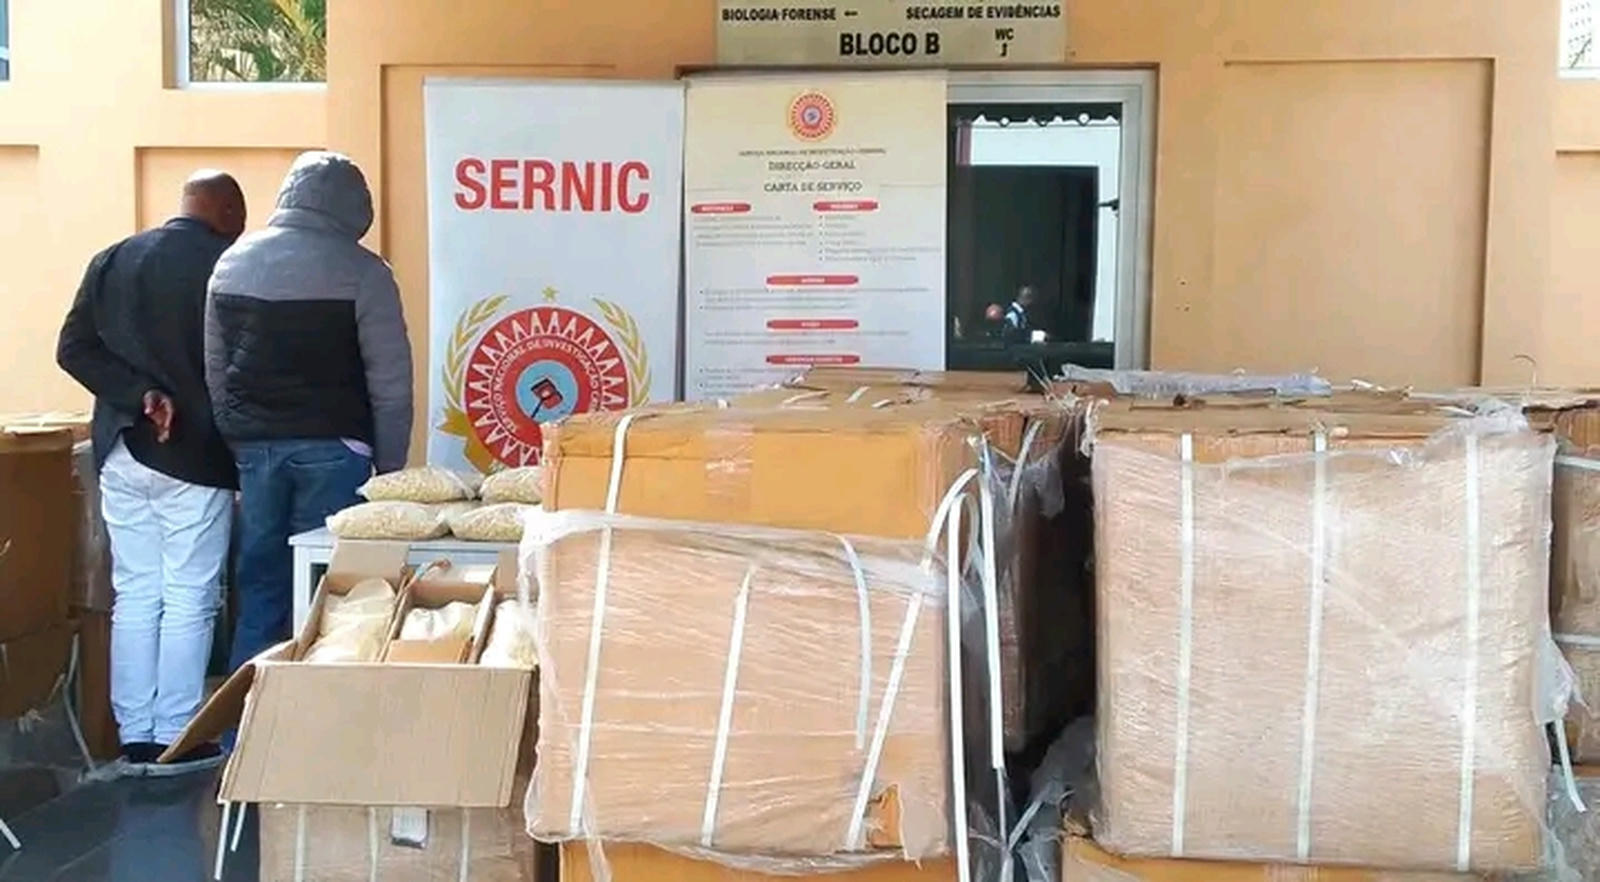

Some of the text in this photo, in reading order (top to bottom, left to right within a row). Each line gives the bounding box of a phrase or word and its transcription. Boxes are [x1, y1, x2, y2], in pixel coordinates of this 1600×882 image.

[721, 8, 837, 21] BIOLOGIA FORENSE
[906, 4, 1061, 20] SECAGEM DE EVIDÊNCIAS
[994, 28, 1015, 41] WC
[839, 32, 941, 56] BLOCO B
[455, 158, 649, 213] SERNIC
[764, 182, 798, 192] CARTA
